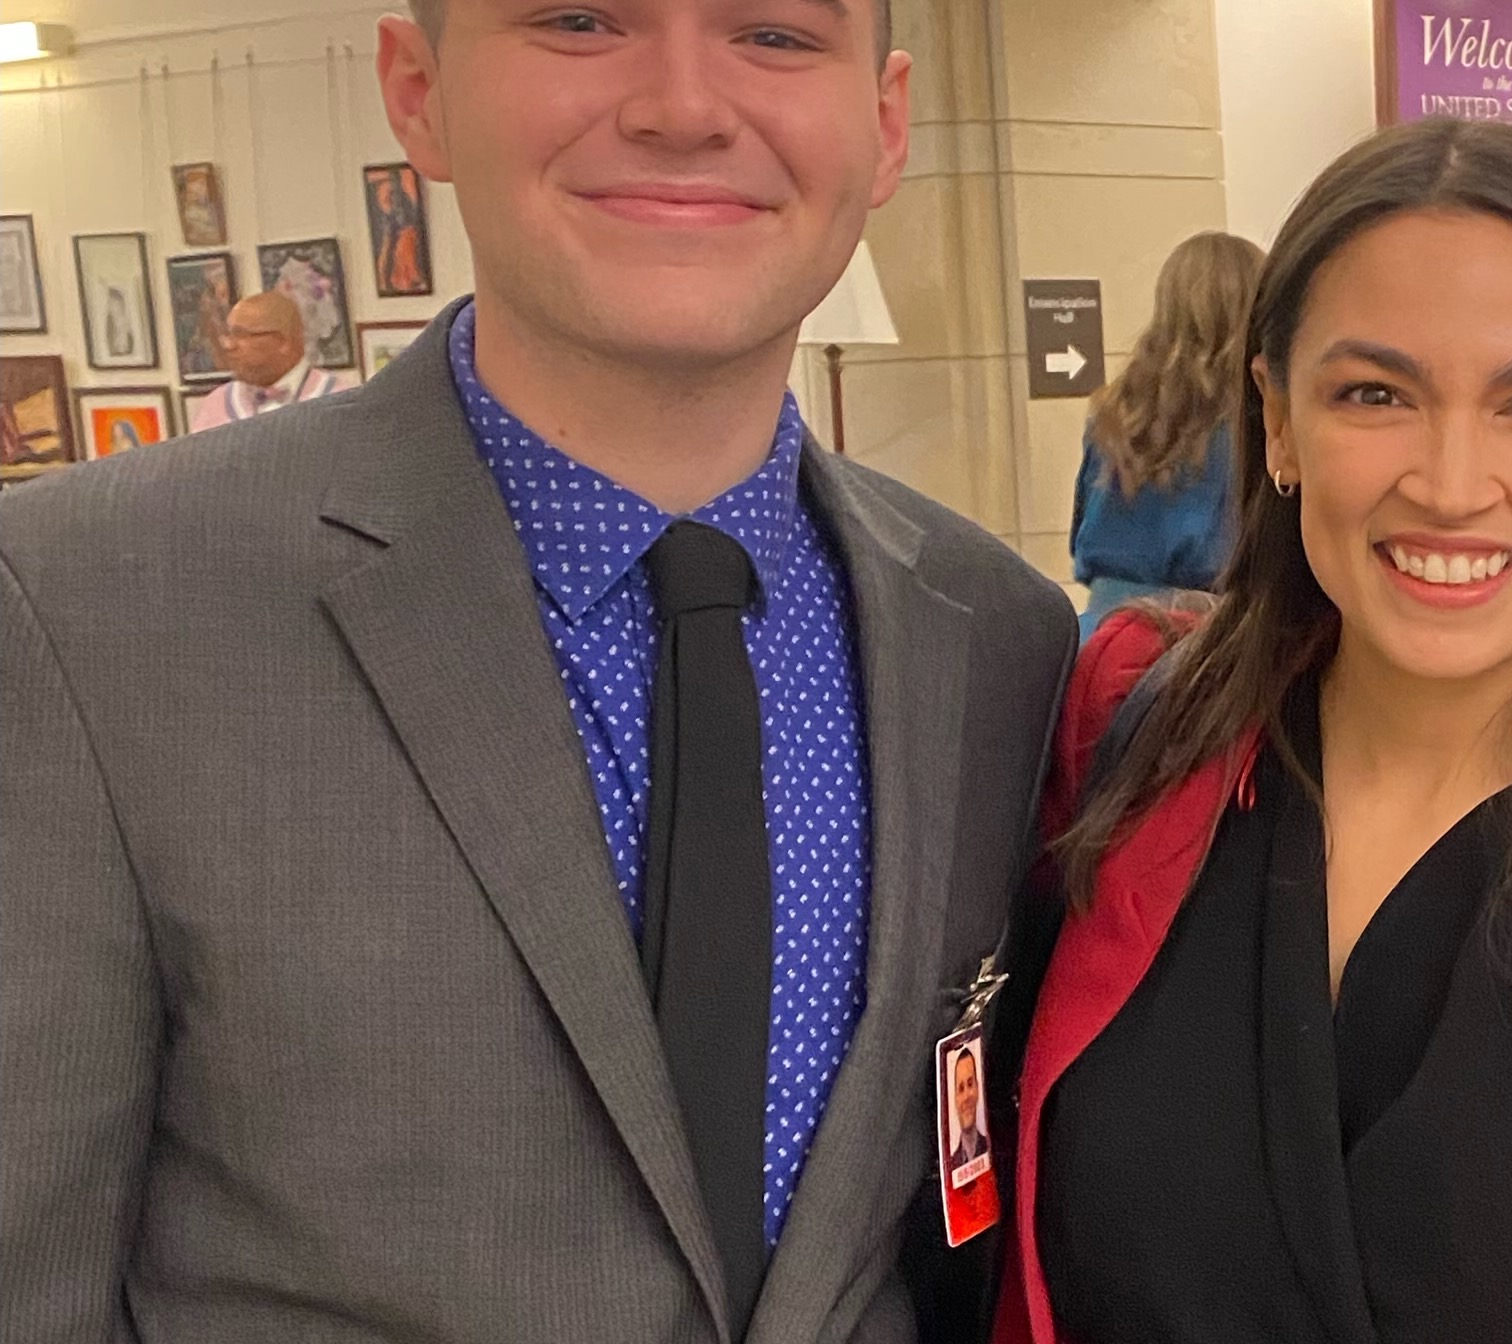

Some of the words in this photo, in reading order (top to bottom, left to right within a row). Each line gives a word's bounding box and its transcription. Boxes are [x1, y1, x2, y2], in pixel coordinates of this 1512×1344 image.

[1482, 76, 1494, 90] to
[1496, 75, 1512, 91] the
[1421, 93, 1501, 118] UNITED
[1053, 311, 1075, 324] Hall
